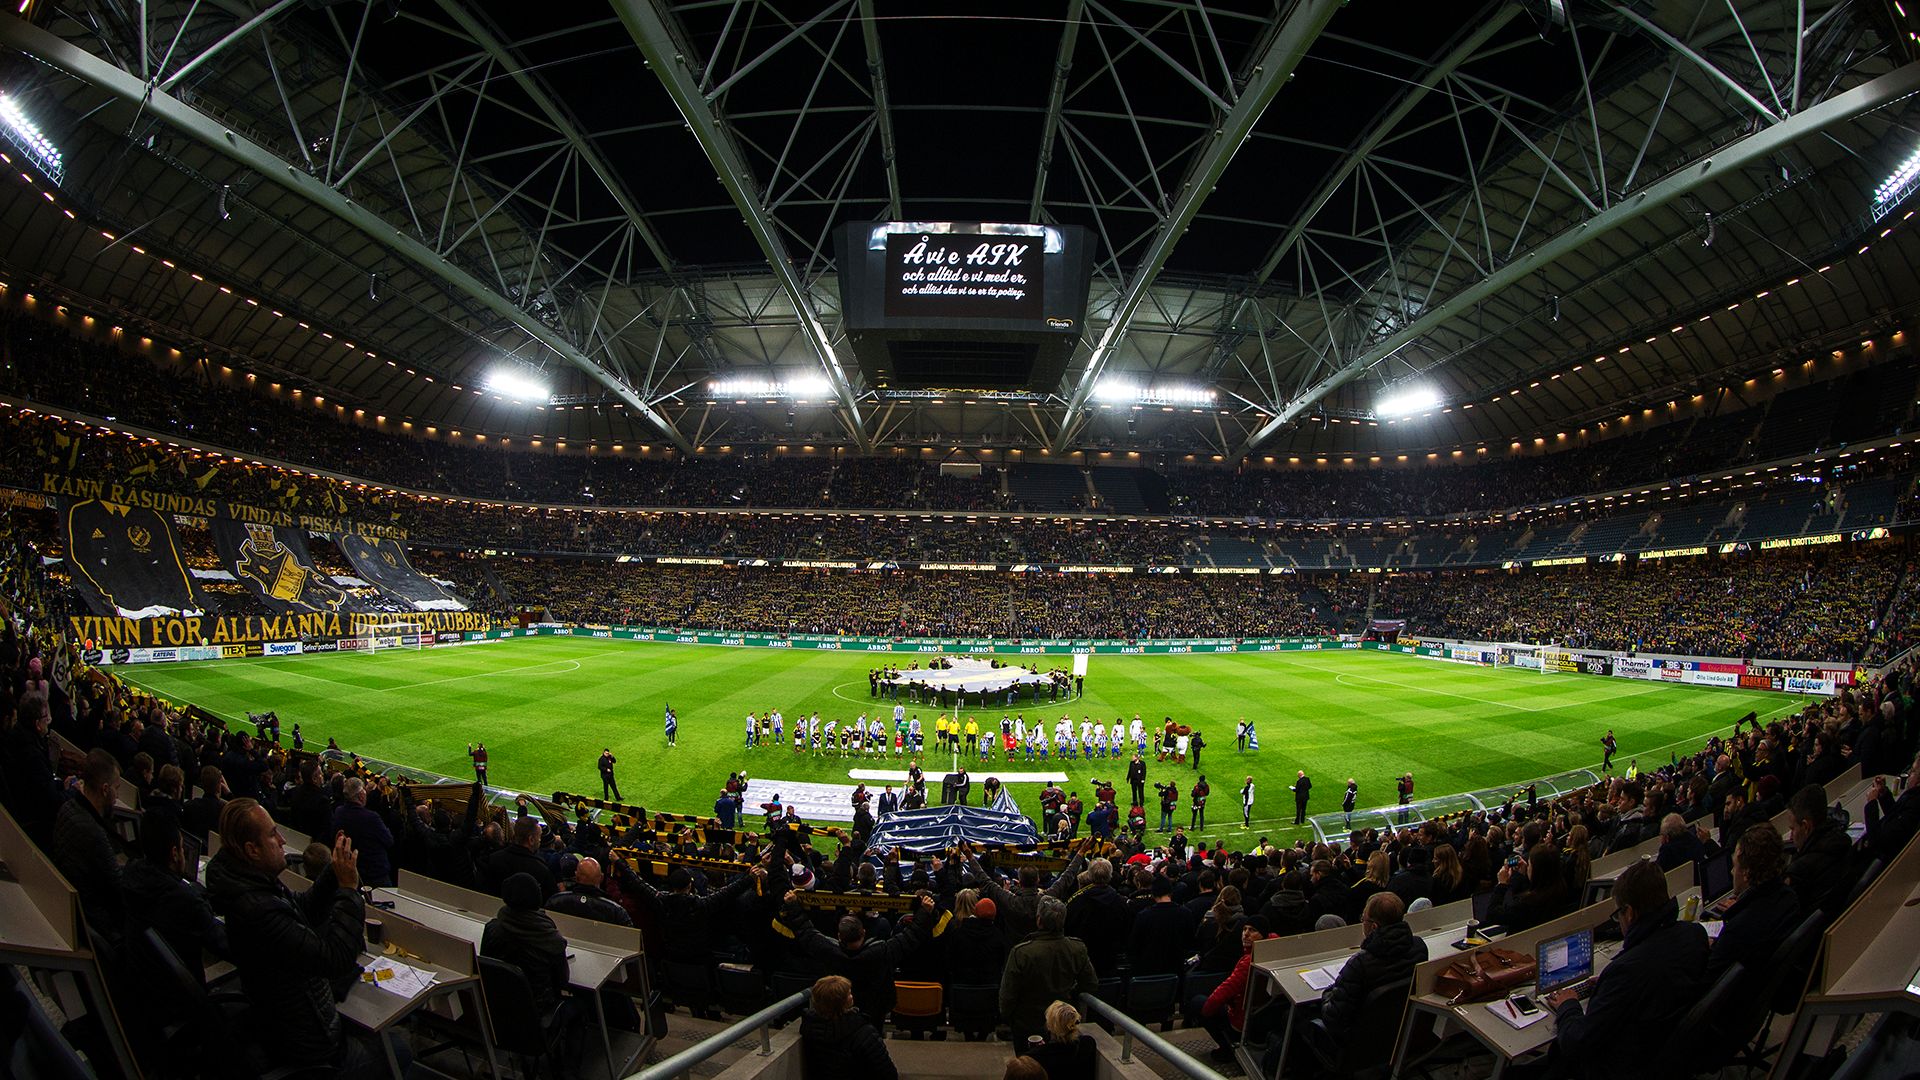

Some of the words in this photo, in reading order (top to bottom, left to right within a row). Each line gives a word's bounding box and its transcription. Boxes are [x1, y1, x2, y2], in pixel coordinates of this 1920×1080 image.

[904, 236, 929, 264] Å
[926, 247, 945, 264] vi
[948, 252, 960, 264] e
[967, 243, 1028, 266] AIK
[903, 267, 925, 281] och
[927, 266, 962, 282] alltid
[962, 273, 970, 282] e
[971, 271, 983, 282] vi
[984, 269, 1011, 282] med
[1010, 274, 1027, 284] er,
[902, 284, 918, 294] och
[919, 284, 942, 294] alltid
[943, 284, 957, 295] ska
[958, 287, 967, 295] vi
[987, 287, 997, 295] ta
[995, 288, 1025, 300] poäng.
[228, 503, 293, 528] VINDAR
[299, 516, 343, 533] PISKA
[348, 519, 354, 534] I
[356, 522, 408, 540] RYGGEN
[70, 616, 141, 646] VINN
[151, 611, 202, 646] FÖR
[212, 610, 343, 643] ALLMÄNNA
[349, 611, 490, 635] IDROTTSKLUBBEN
[223, 646, 244, 654] ITEX
[270, 644, 295, 654] Swegon
[1748, 667, 1761, 676] XL
